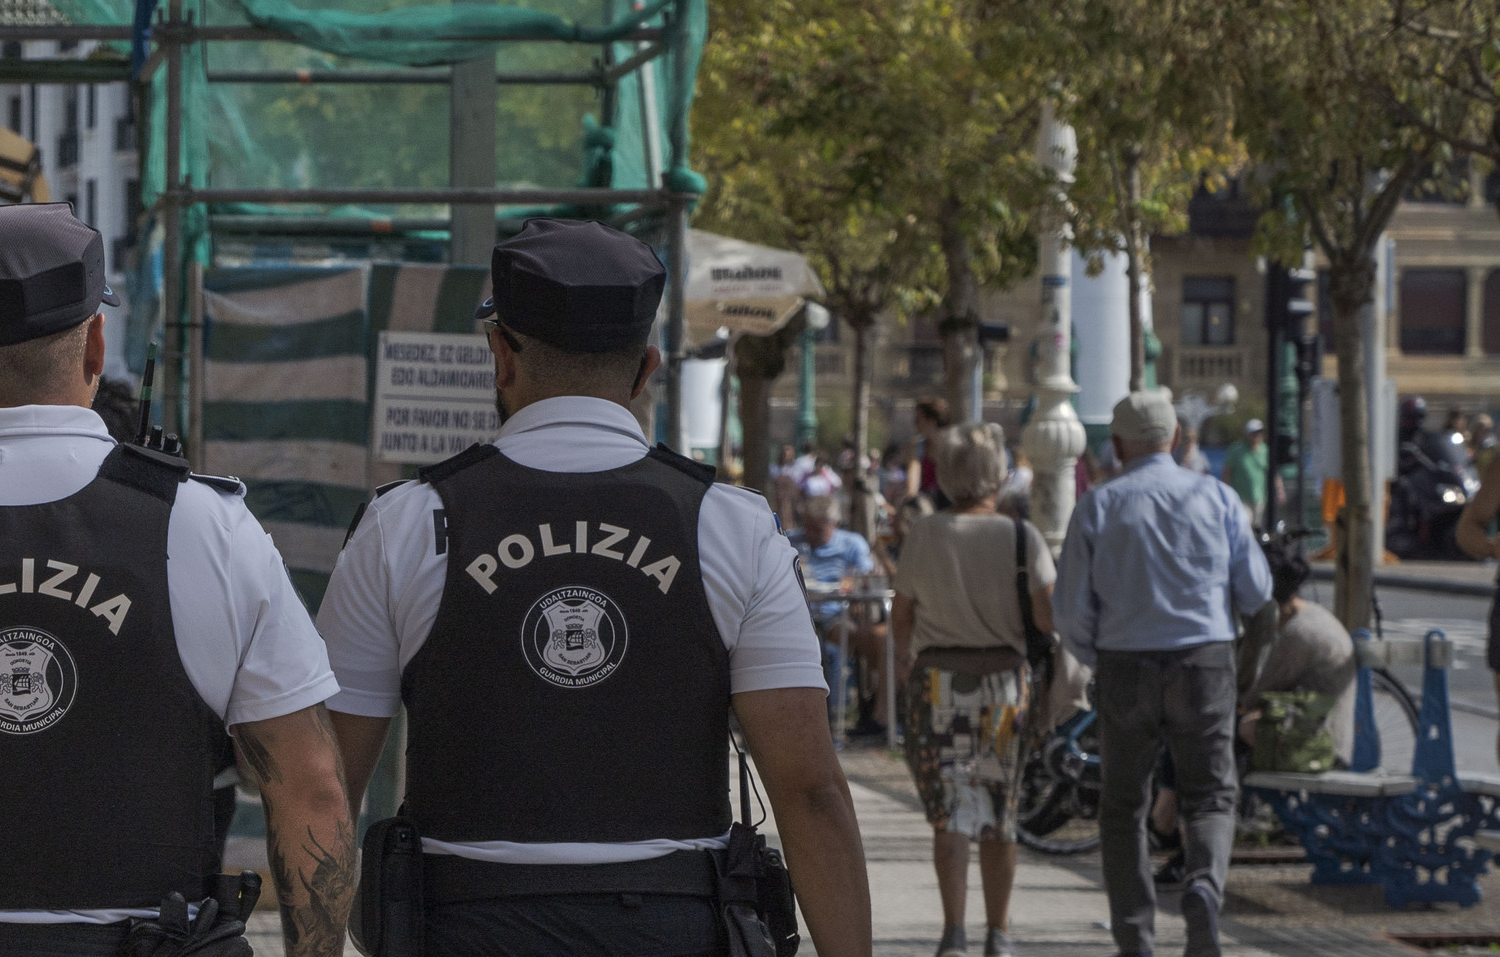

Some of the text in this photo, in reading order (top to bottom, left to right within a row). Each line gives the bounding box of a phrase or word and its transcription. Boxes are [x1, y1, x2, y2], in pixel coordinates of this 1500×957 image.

[386, 406, 409, 426] POR
[412, 407, 449, 428] FAVOR
[452, 409, 470, 429] NO
[381, 431, 417, 452] JUNTO
[420, 433, 428, 452] A
[431, 434, 445, 454] LA
[465, 520, 682, 595] POLIZIA
[539, 589, 608, 609] UDALTZAINGOA
[558, 652, 567, 663] SAN
[539, 661, 617, 686] GUARDIA MUNICIPAL
[4, 697, 14, 709] SAN
[22, 706, 65, 732] MUNICIPAL
